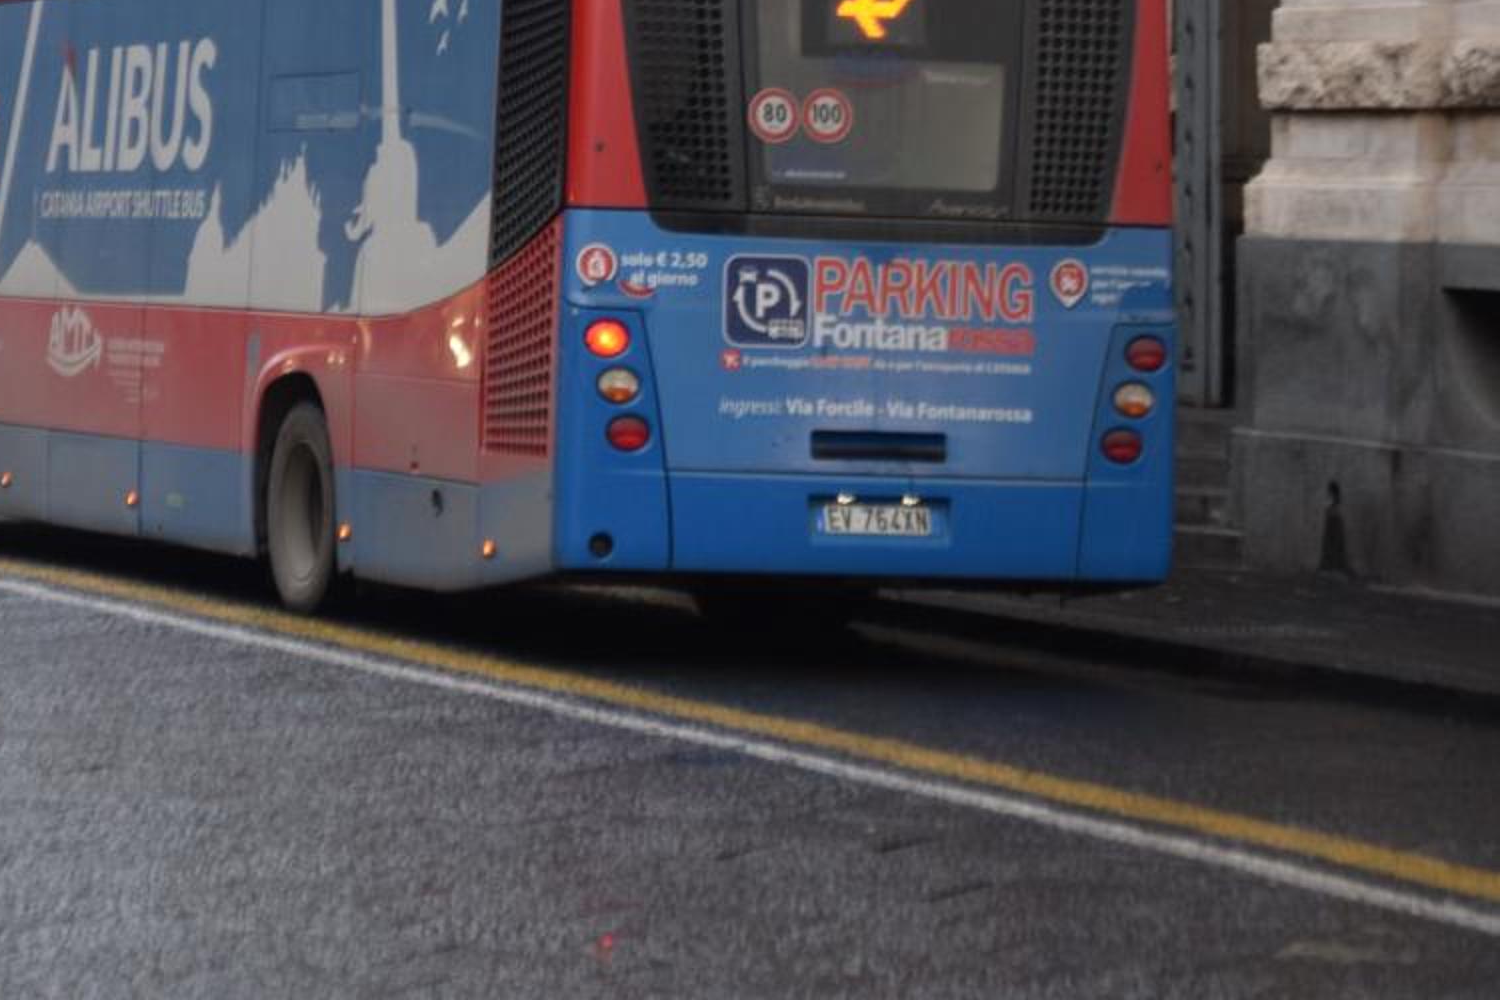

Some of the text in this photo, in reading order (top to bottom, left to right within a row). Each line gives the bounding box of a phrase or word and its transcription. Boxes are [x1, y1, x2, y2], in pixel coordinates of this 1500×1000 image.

[45, 36, 217, 172] ALIBUS
[762, 103, 789, 123] 80
[812, 103, 842, 123] 100
[86, 189, 130, 218] AIRPORT
[131, 189, 181, 218] SHUTTLE
[182, 188, 206, 218] BUS
[646, 271, 699, 289] giorno
[814, 256, 1034, 323] PARKING
[786, 398, 813, 415] Via
[886, 400, 914, 418] Via
[917, 402, 1032, 424] Fontanarossa
